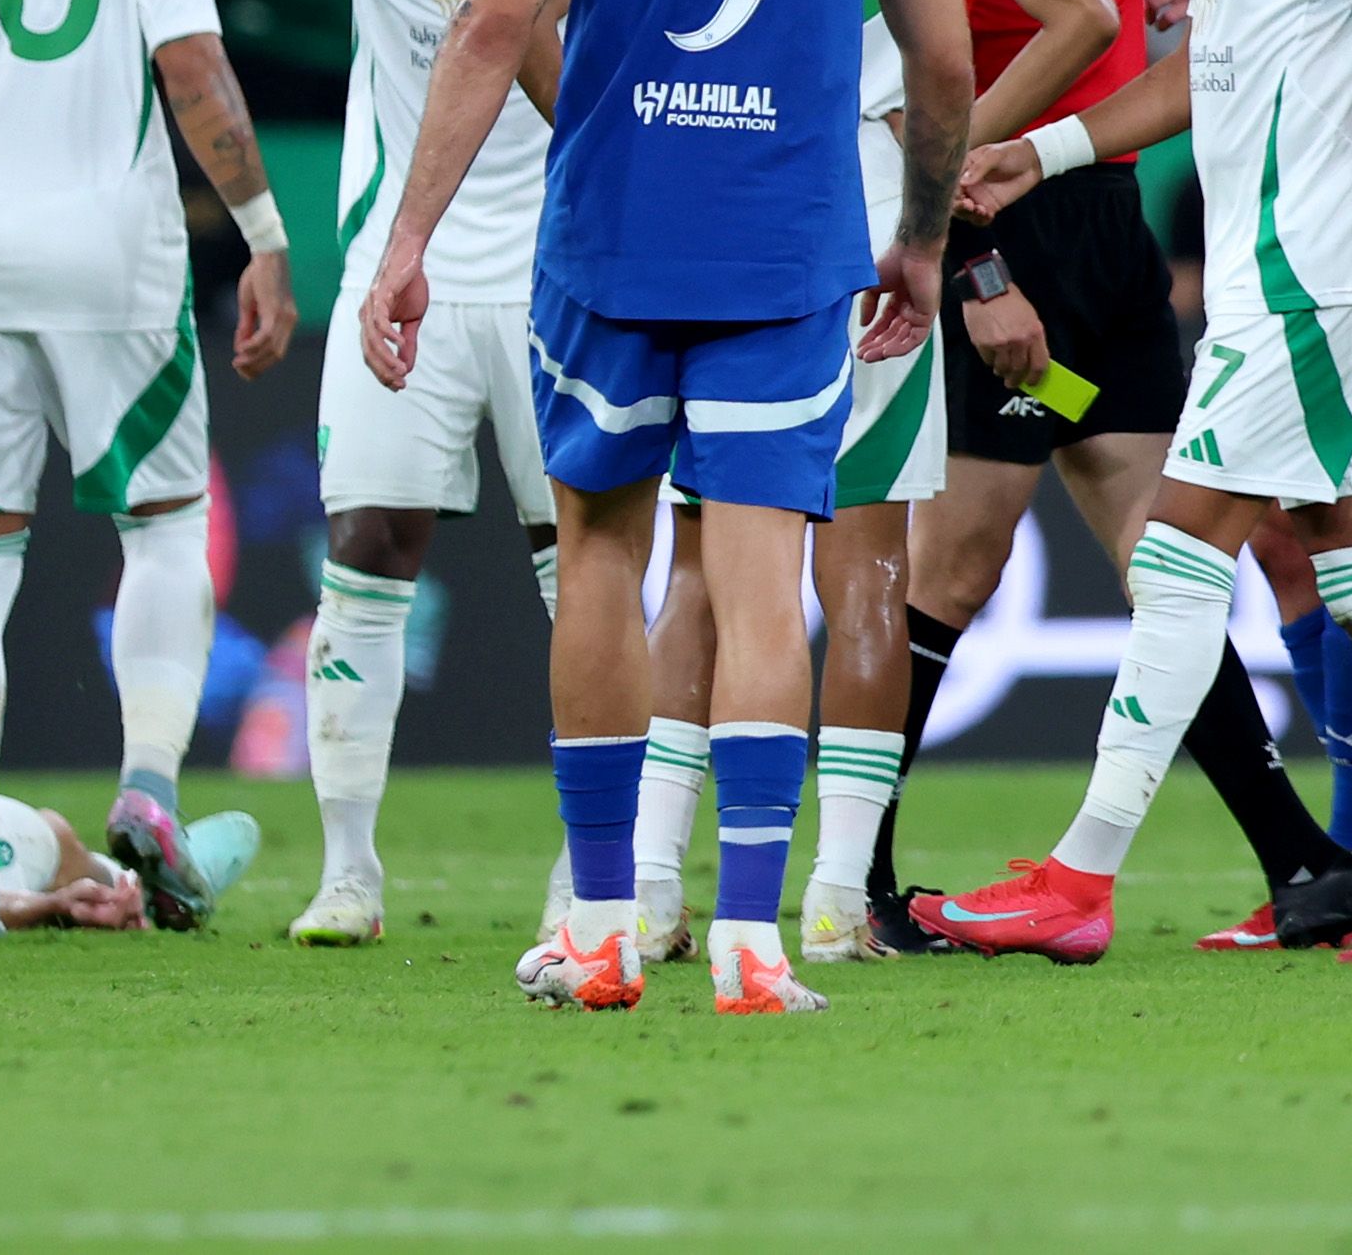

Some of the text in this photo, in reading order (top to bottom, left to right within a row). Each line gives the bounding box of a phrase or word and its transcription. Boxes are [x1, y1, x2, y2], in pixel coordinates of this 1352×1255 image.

[668, 82, 777, 116] ALHILAL
[666, 113, 777, 132] FOUNDATION
[1196, 343, 1246, 410] 7
[998, 396, 1046, 417] AFC
